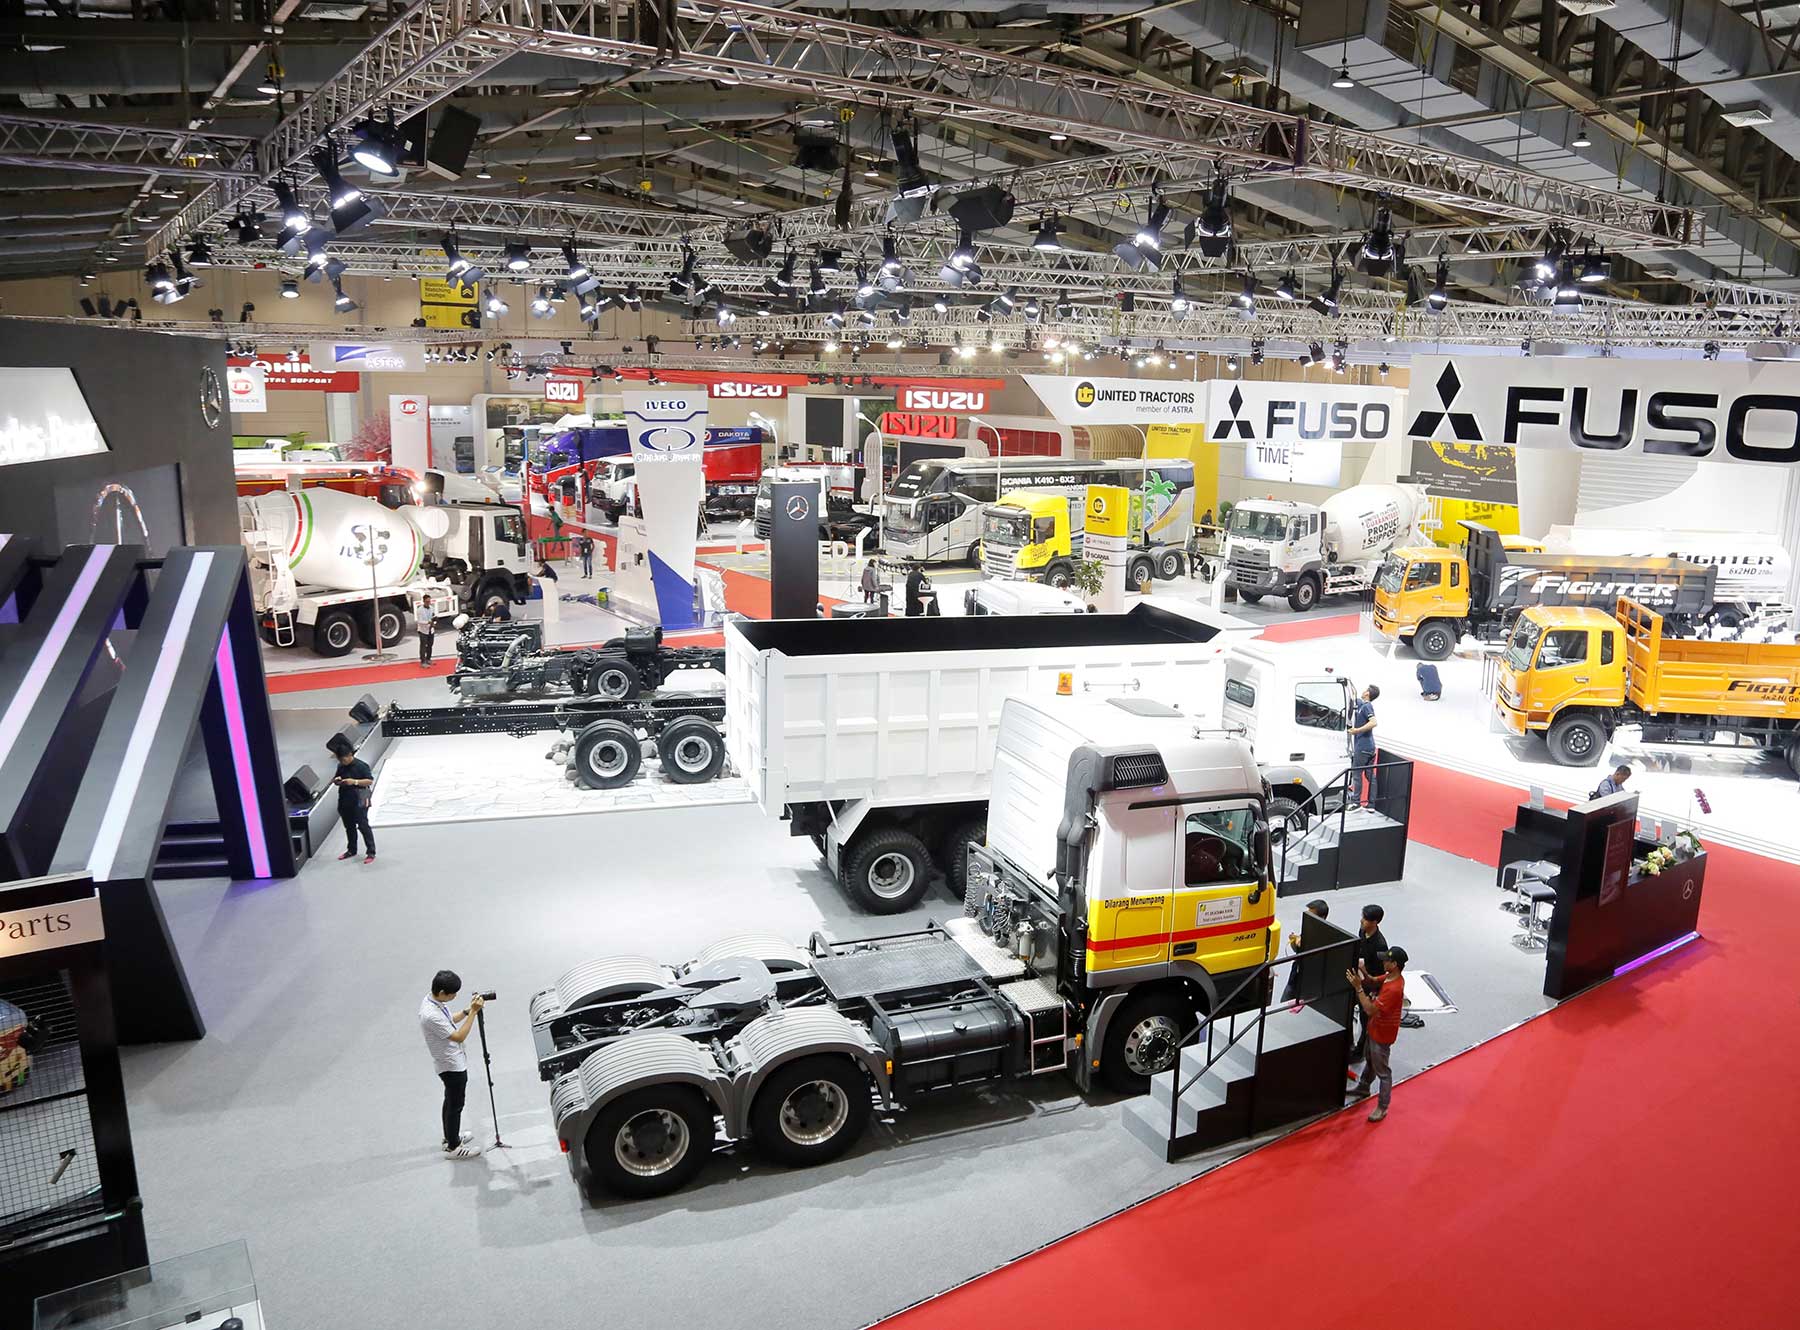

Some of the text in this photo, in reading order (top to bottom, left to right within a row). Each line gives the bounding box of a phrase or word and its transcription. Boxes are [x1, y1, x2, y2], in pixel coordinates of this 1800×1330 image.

[546, 382, 579, 400] ISUZU
[713, 382, 782, 397] ISUZU
[905, 390, 984, 410] ISUZU
[1097, 390, 1195, 404] UNITED TRACTORS
[646, 400, 687, 410] IVECO
[1136, 405, 1193, 414] member of ASTRA
[881, 412, 957, 438] ISUZU
[1266, 400, 1390, 440] FUSO
[1503, 386, 1800, 463] FUSO
[1256, 446, 1290, 465] TIME
[1001, 477, 1032, 486] SCANIA
[1034, 475, 1053, 484] K410
[1060, 475, 1076, 483] 6X2
[1091, 552, 1110, 560] SCANIA
[1530, 575, 1678, 597] FIGHTER
[1727, 680, 1800, 694] FIGHT
[1104, 895, 1165, 909] Dilarang Menumpang
[1233, 933, 1257, 942] 2640
